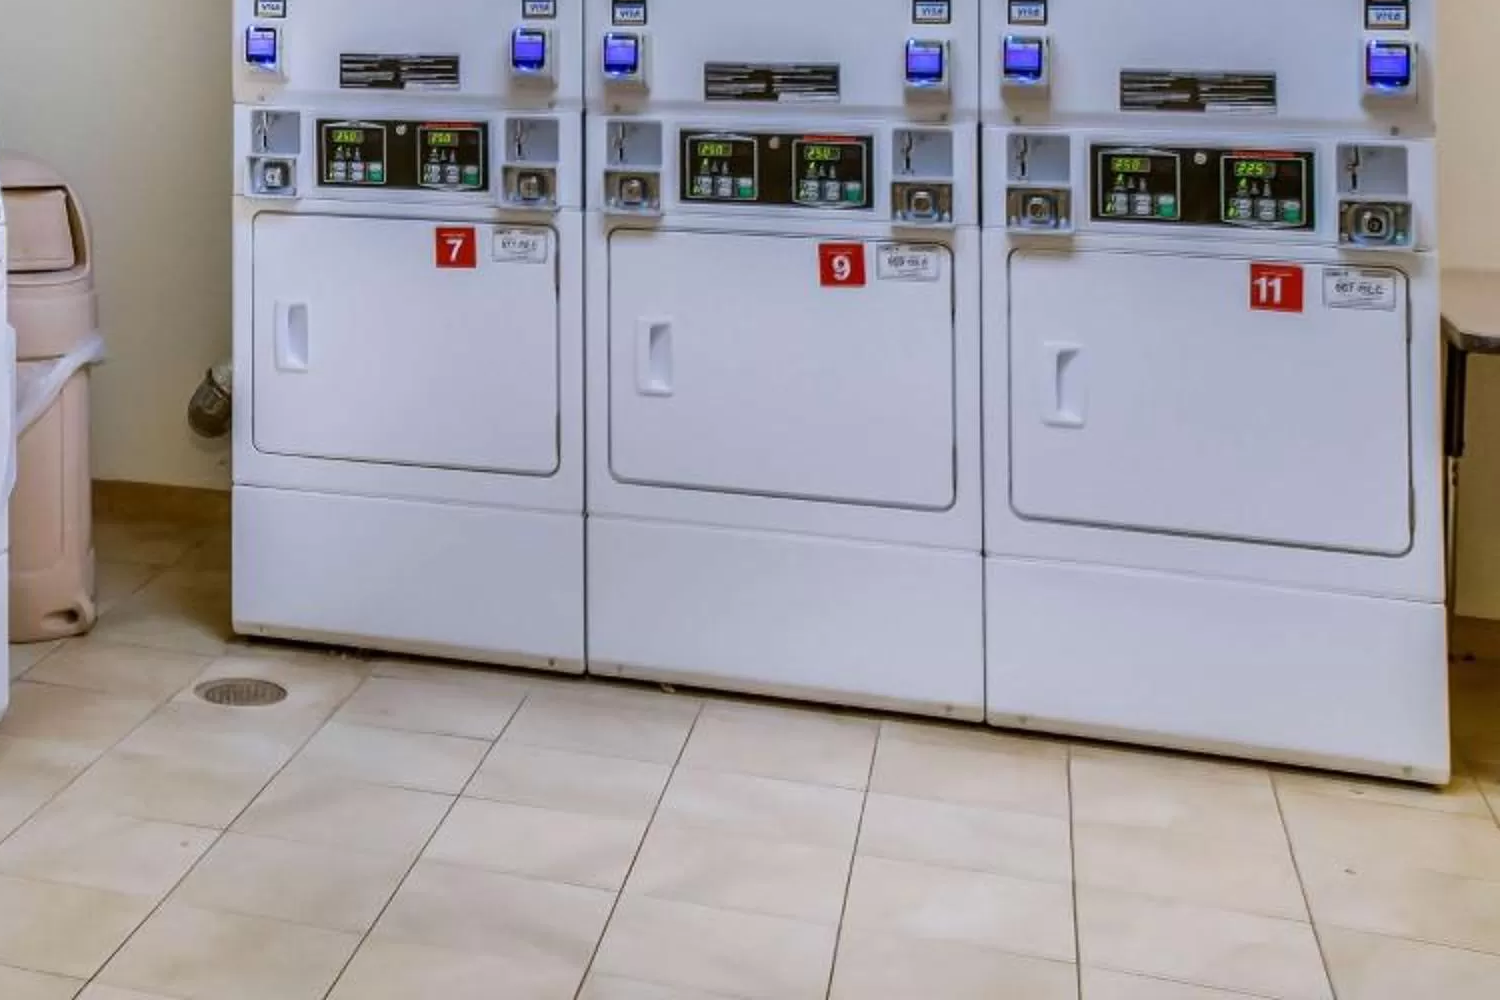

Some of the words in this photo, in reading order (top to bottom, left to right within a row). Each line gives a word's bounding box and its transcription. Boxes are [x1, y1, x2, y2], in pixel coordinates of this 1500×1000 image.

[1236, 163, 1263, 176] 225
[445, 238, 464, 262] 7
[832, 255, 851, 281] 9
[1253, 276, 1283, 304] 11
